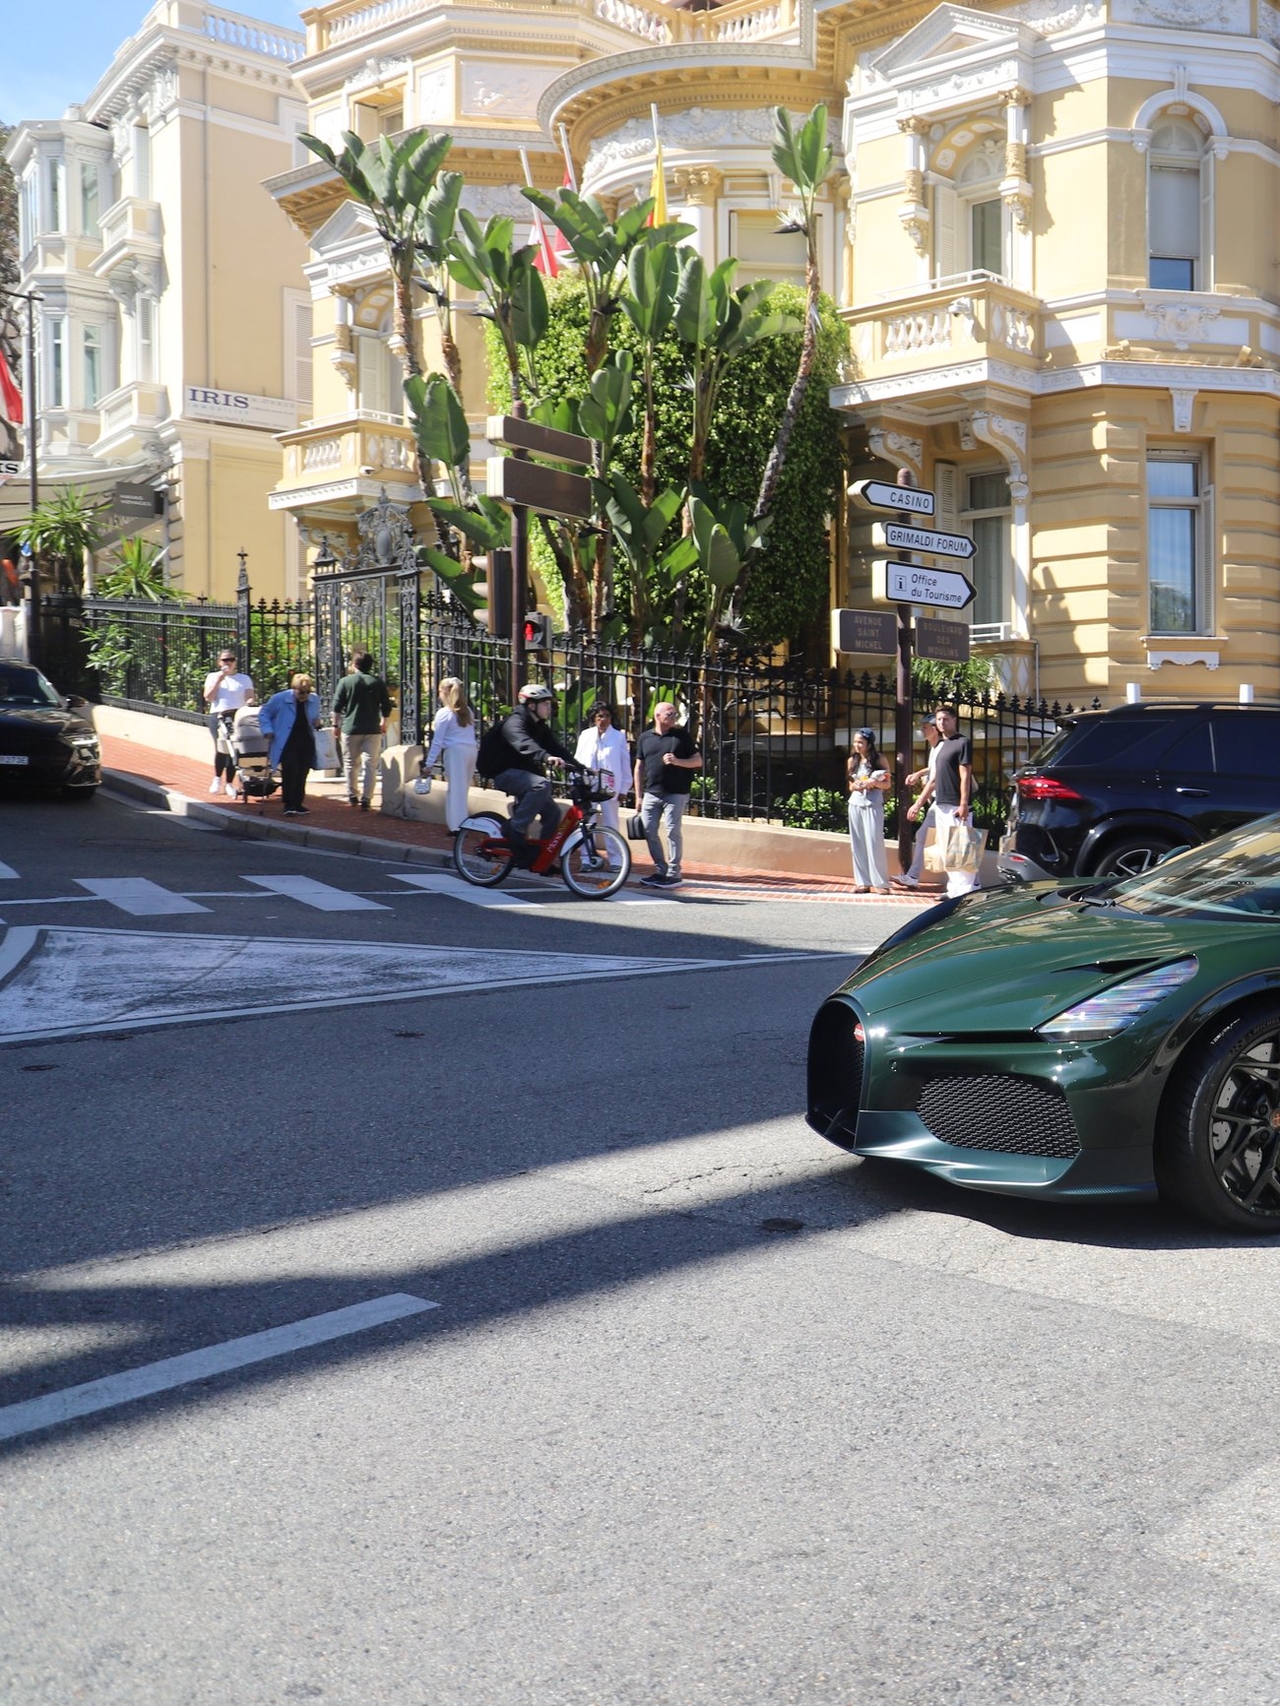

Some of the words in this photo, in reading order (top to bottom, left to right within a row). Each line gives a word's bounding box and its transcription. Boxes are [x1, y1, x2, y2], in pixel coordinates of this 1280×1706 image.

[189, 388, 249, 409] IRIS
[890, 491, 930, 509] CASINO
[890, 530, 934, 547] GRIMALDI
[936, 538, 968, 553] FORUM
[911, 573, 938, 587] Office
[911, 587, 922, 598] du
[925, 589, 962, 603] Tourisme
[854, 615, 882, 627] AVENUE
[857, 628, 879, 638] SAINT
[923, 622, 963, 635] BOULEVARD
[855, 640, 882, 650] MICHEL
[937, 635, 950, 645] DES
[927, 646, 959, 658] MOULINS
